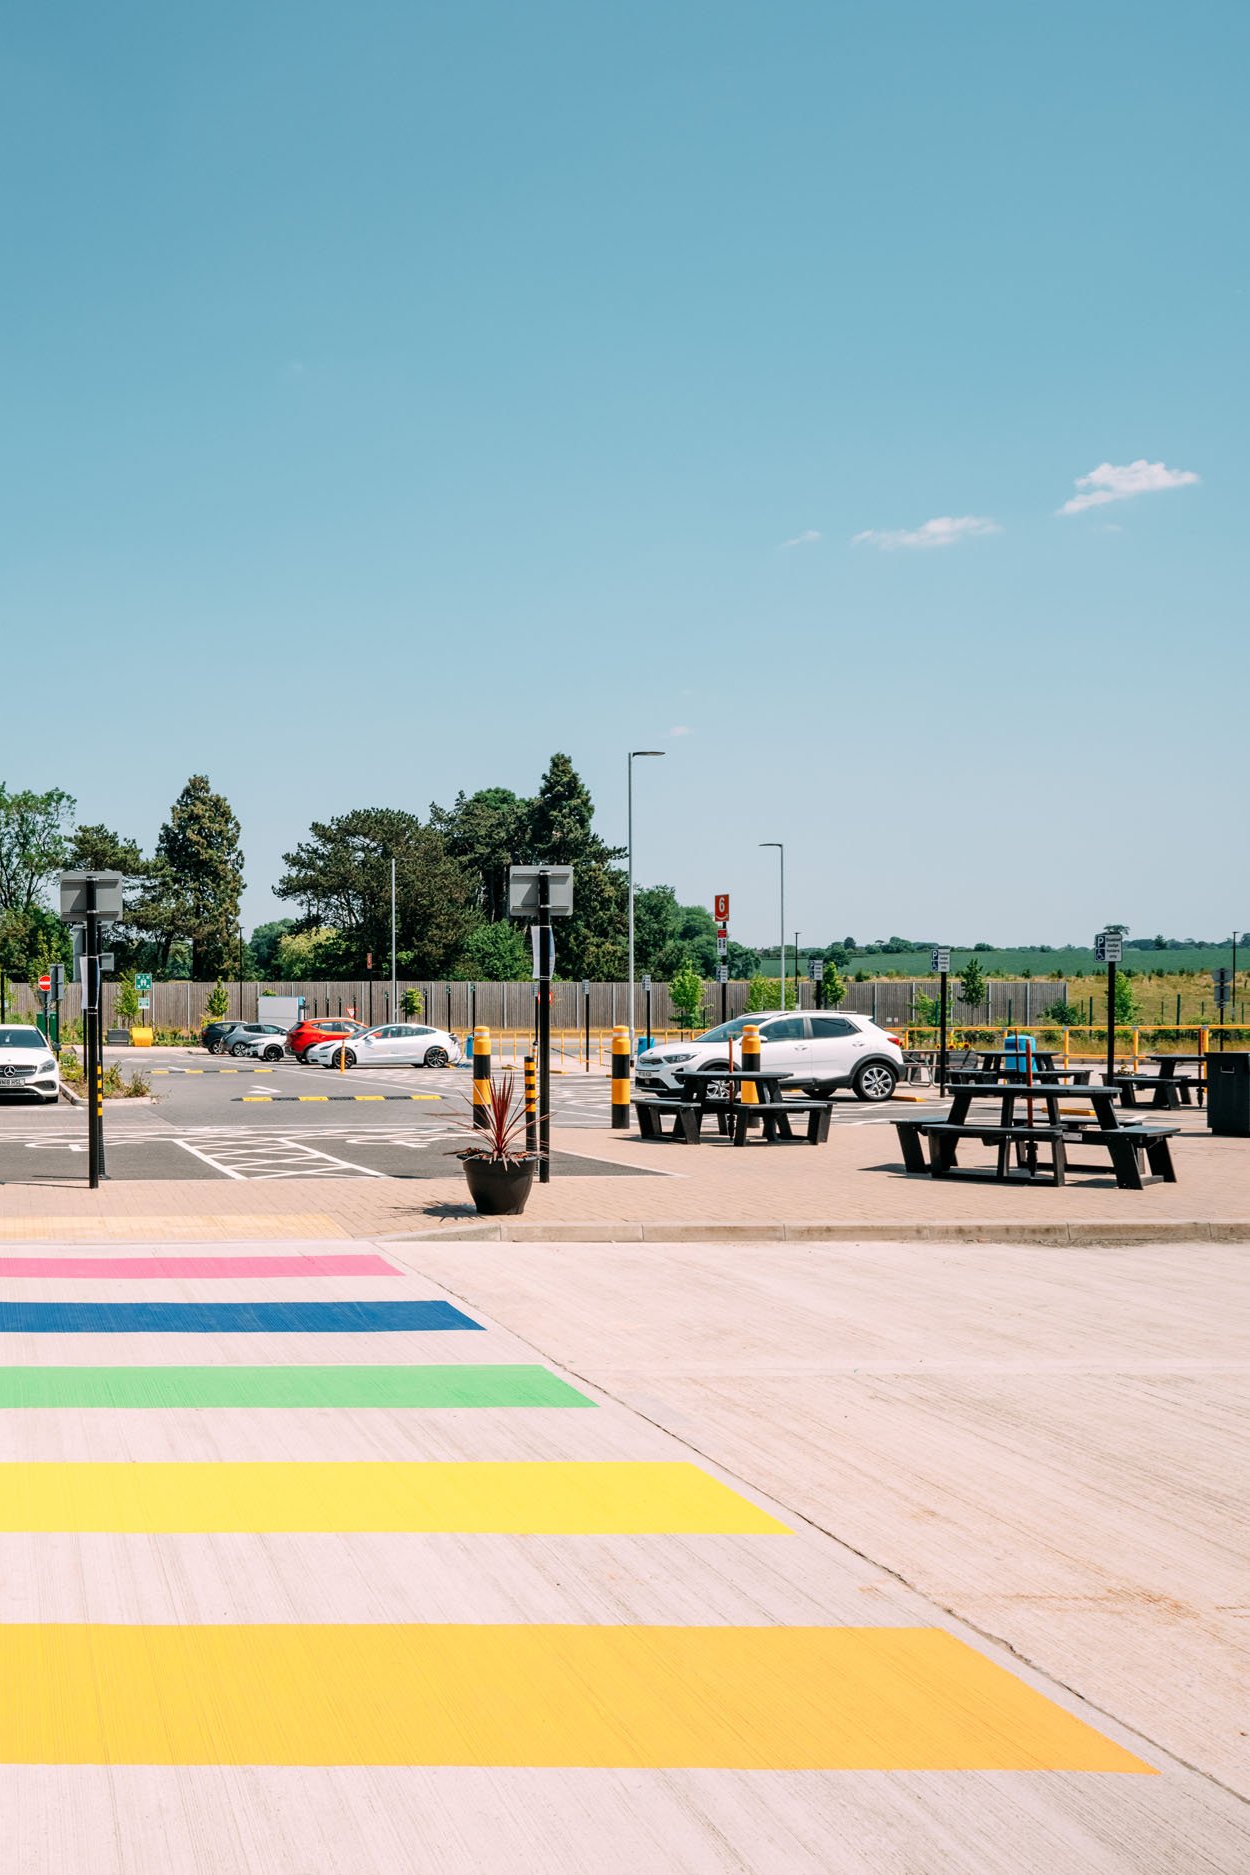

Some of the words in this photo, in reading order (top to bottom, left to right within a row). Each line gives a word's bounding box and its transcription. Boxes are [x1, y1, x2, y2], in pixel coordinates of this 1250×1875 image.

[718, 897, 725, 912] 6
[1097, 936, 1104, 947] P
[932, 950, 937, 960] P
